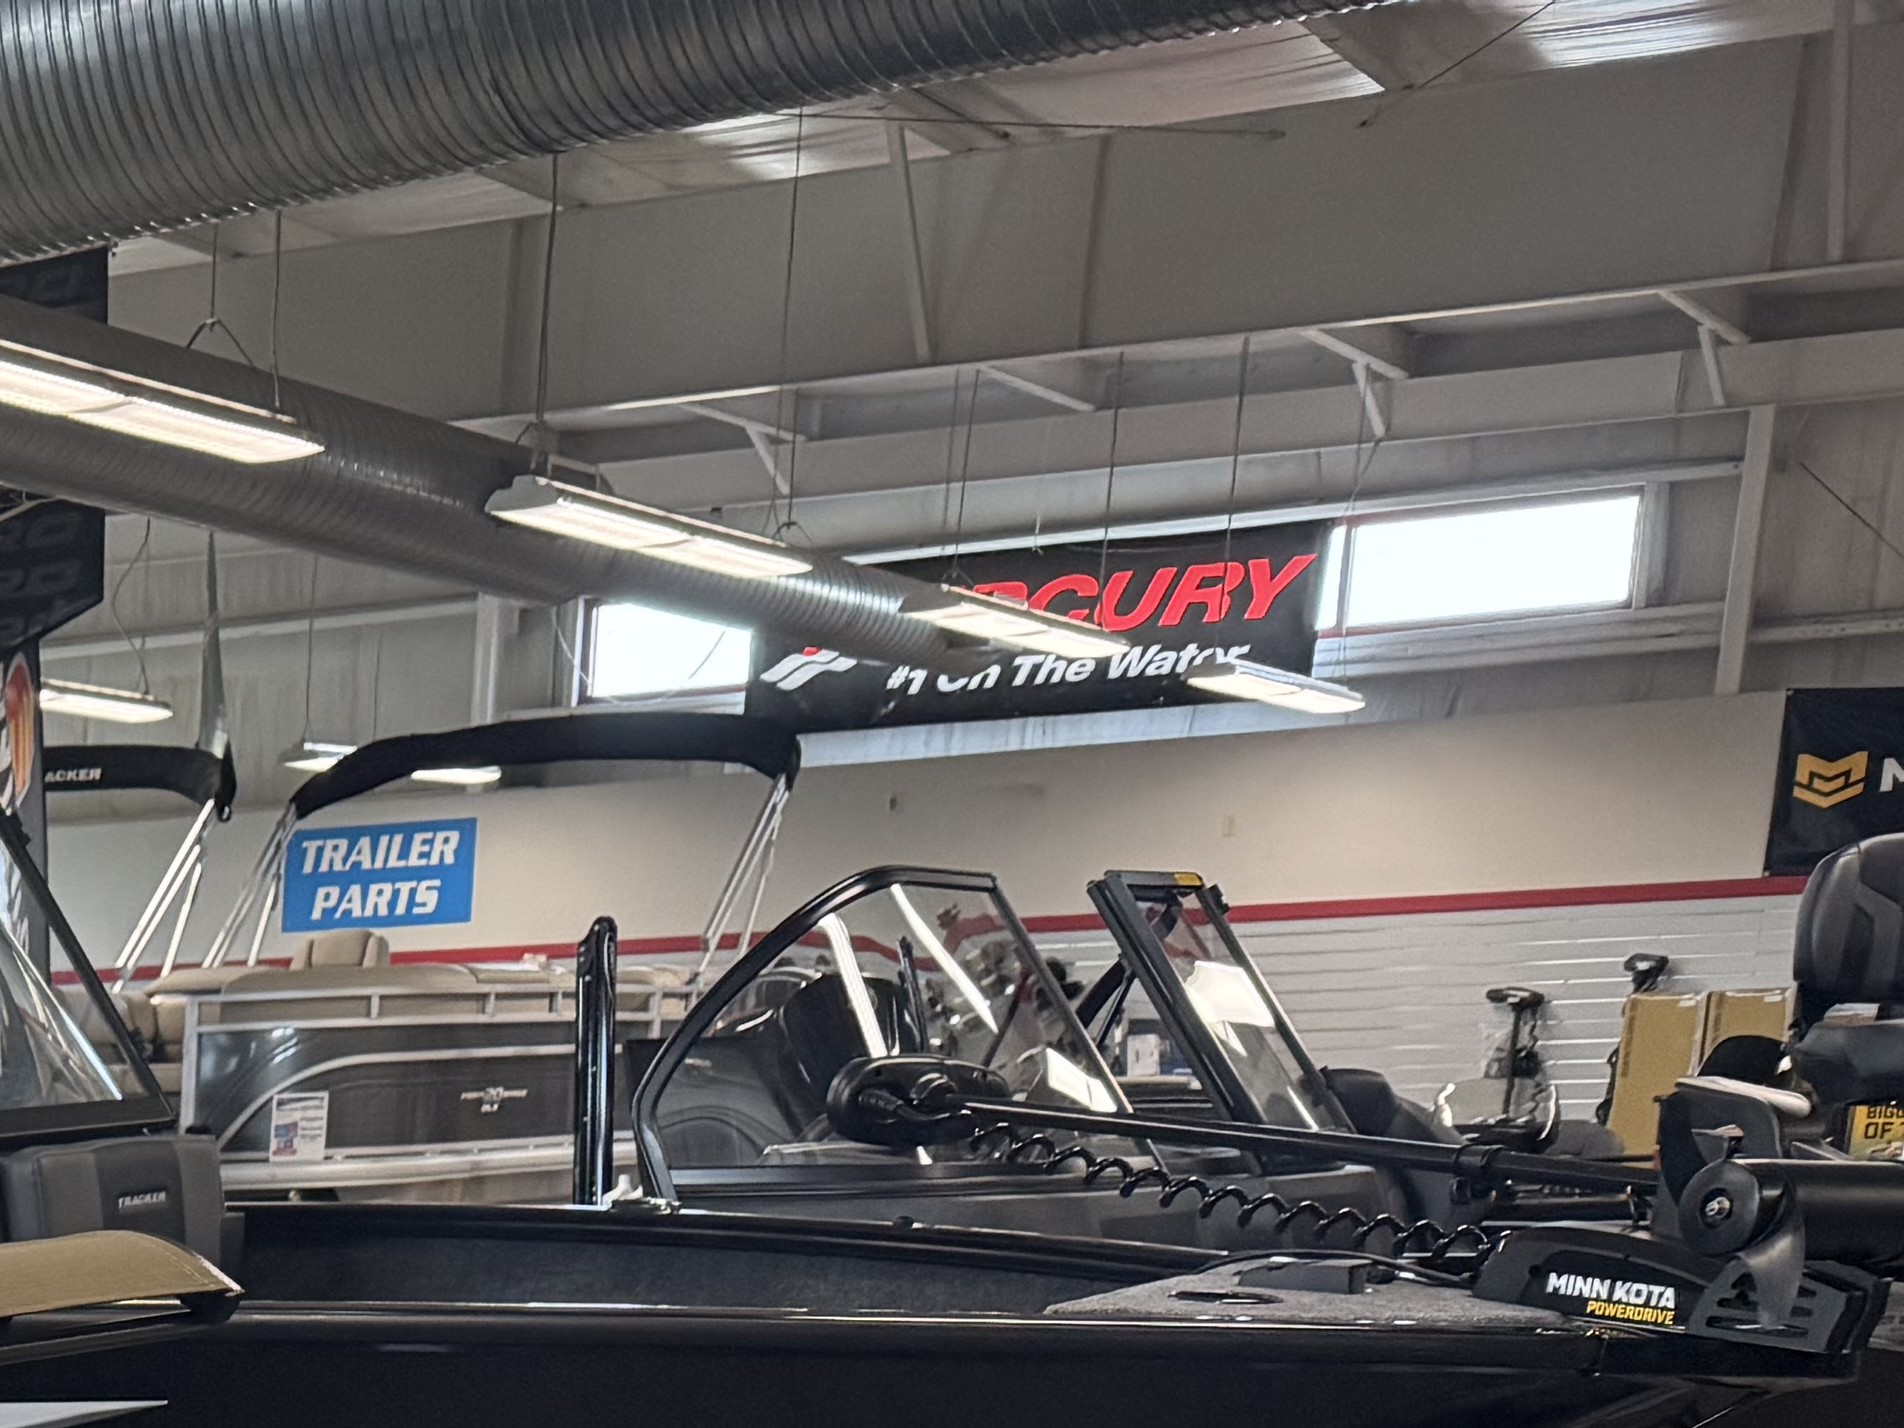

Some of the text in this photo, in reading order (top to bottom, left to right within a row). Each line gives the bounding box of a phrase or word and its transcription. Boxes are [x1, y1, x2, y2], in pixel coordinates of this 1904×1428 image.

[886, 668, 927, 695] #1
[1008, 652, 1099, 688] The
[302, 830, 460, 874] TRAILER
[310, 878, 442, 921] PARTS
[1545, 1271, 1676, 1309] MINN KOTA
[1586, 1300, 1676, 1325] POWERDRIVE
